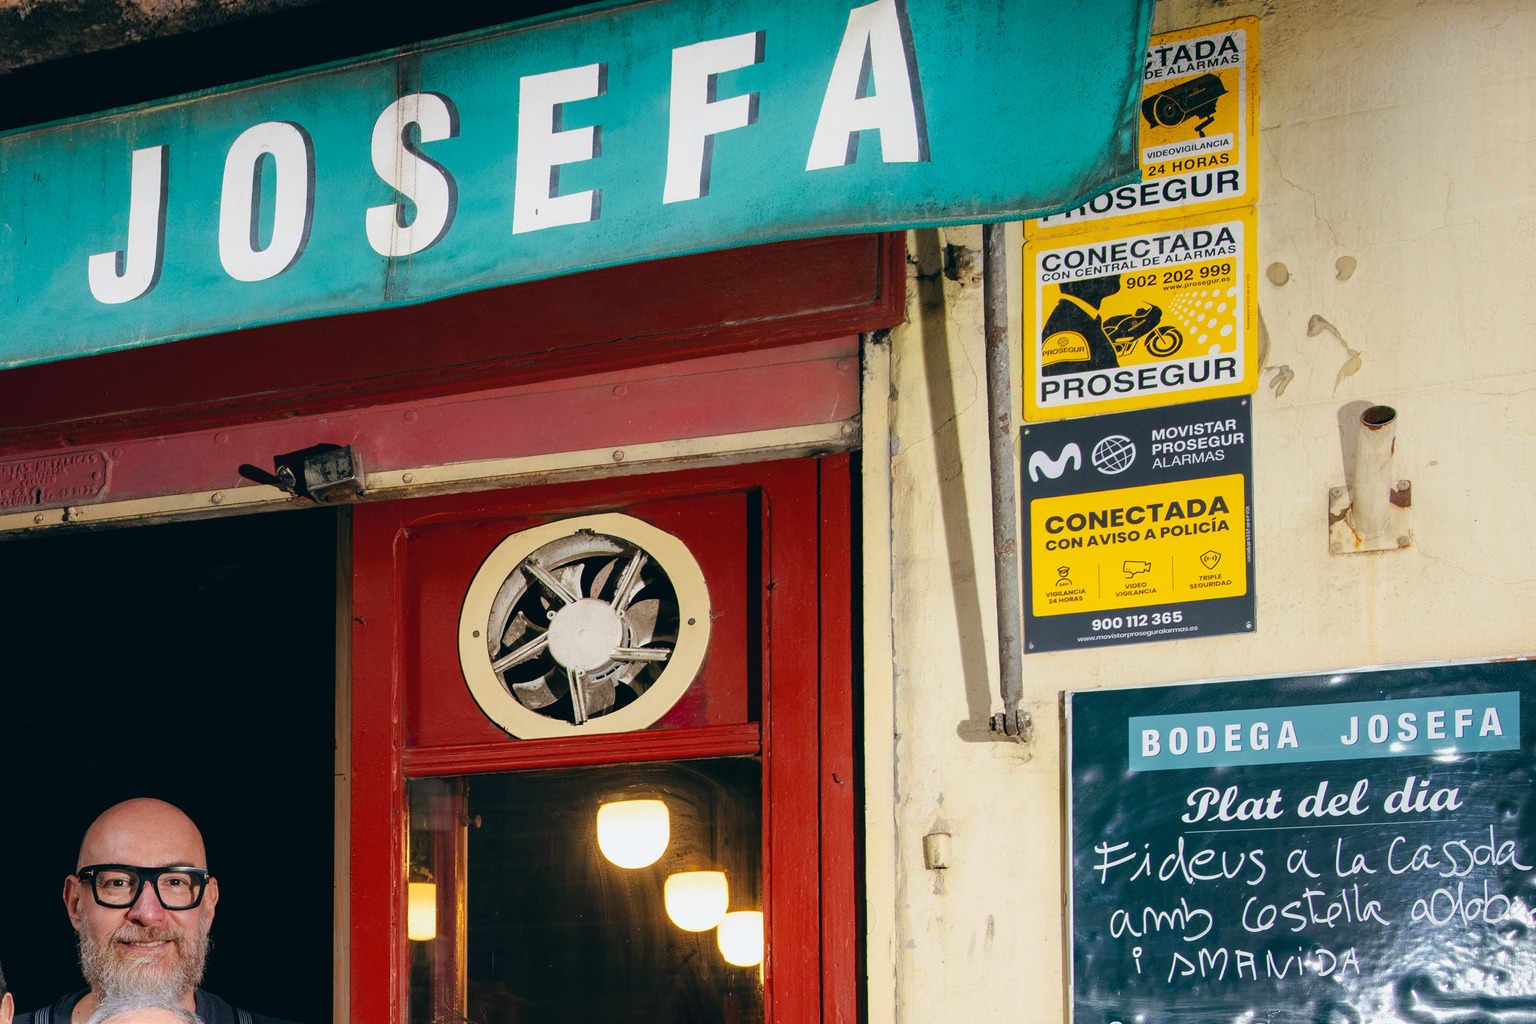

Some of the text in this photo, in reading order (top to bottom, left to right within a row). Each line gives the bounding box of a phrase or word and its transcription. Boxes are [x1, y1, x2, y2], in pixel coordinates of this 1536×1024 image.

[1145, 54, 1239, 80] DE ALARMAS
[87, 0, 931, 305] JOSEFA
[1146, 138, 1230, 160] VIDEOVIGILANCIA
[1148, 153, 1230, 177] 24 HORAS
[1041, 226, 1236, 273] CONECTADA
[1041, 245, 1237, 282] CON CENTRAL DE ALARMAS
[1126, 263, 1232, 290] 902 202 999
[1162, 276, 1231, 292] www.prosegur.es
[1041, 345, 1085, 357] PROSEGUR
[1041, 356, 1237, 402] PROSEGUR
[1152, 418, 1237, 442] MOVISTAR
[1152, 432, 1245, 456] PROSEGUR
[1152, 449, 1225, 470] ALARMAS
[1045, 495, 1230, 534] CONECTADA
[1045, 517, 1230, 552] CON AVISO A POLICÍA
[1125, 582, 1147, 590] VIDEO
[1189, 579, 1233, 590] SEGURIDAD
[1199, 573, 1223, 581] TRIPLE
[1045, 588, 1086, 598] VIGILANCIA
[1115, 588, 1157, 598] VIGILANCIA
[1091, 610, 1184, 632] 900 112 365
[1141, 706, 1504, 758] BODEGA JOSEFA
[1180, 775, 1464, 824] Plat del dia
[1286, 857, 1321, 878] a
[1336, 836, 1377, 878] la
[1109, 896, 1213, 942] amb
[1131, 946, 1143, 975] i
